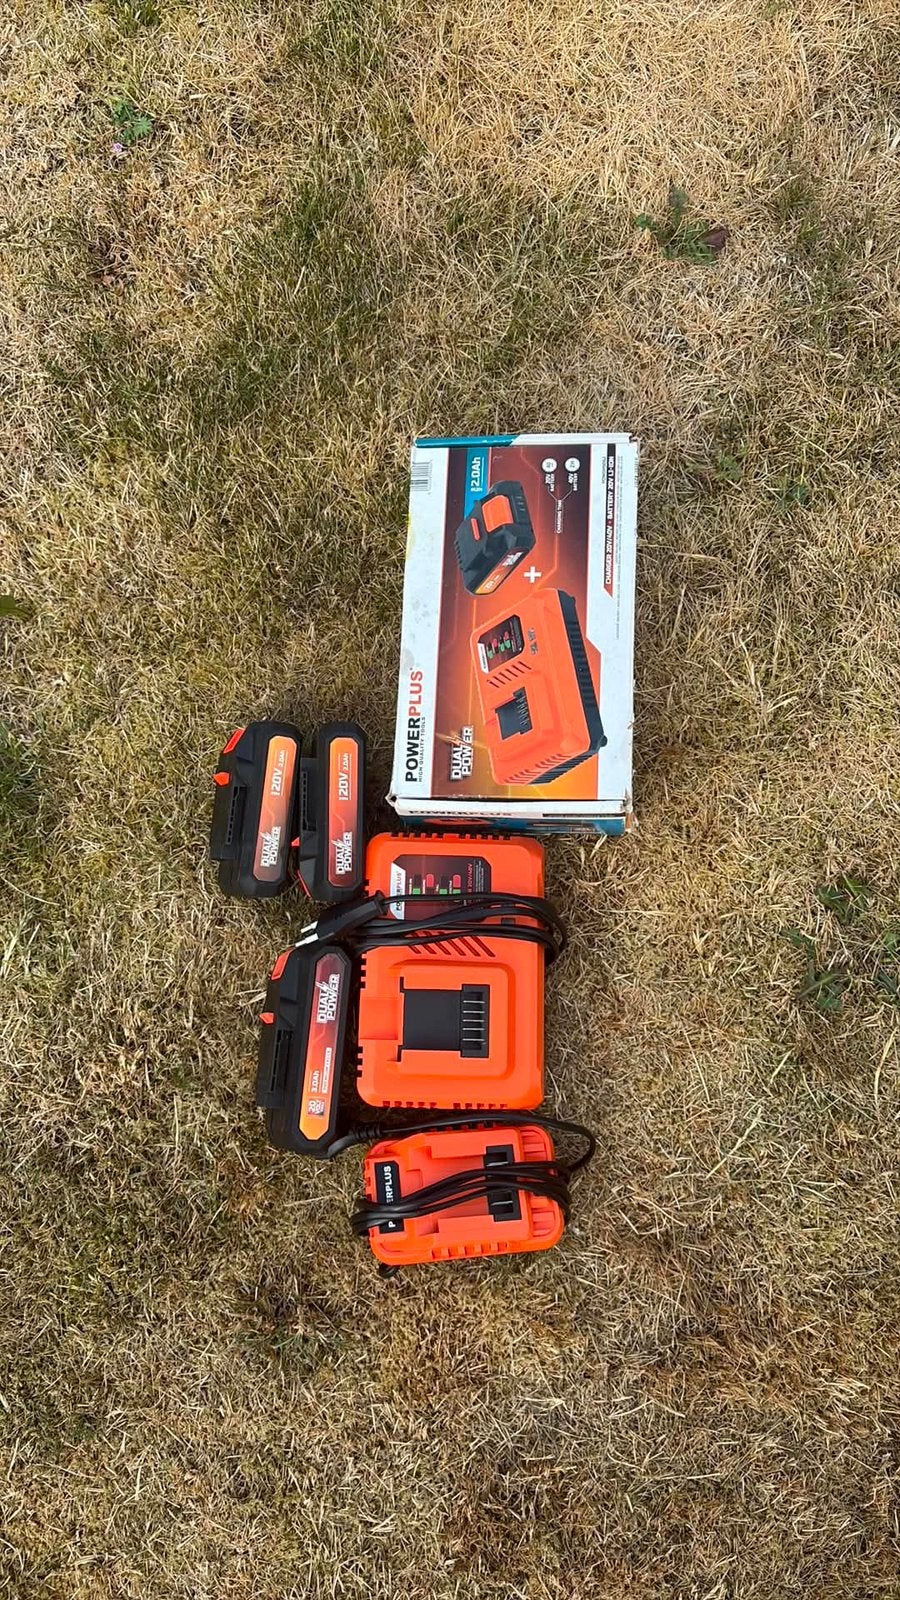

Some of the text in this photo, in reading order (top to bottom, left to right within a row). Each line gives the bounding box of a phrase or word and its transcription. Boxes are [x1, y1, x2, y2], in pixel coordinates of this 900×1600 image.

[471, 456, 481, 487] 2.0Ah
[405, 671, 422, 782] POWERPLUS
[451, 744, 462, 779] DUAL
[462, 726, 473, 775] POWER
[271, 768, 282, 791] 20V
[339, 773, 348, 796] 20V
[261, 839, 270, 867] DUAL
[270, 826, 281, 864] POWER
[336, 846, 345, 874] DUAL
[344, 832, 352, 871] POWER
[316, 990, 328, 1023] DUAL
[326, 974, 339, 1020] POWER
[311, 1070, 320, 1093] 3.0Ah
[309, 1100, 316, 1113] 20
[384, 1166, 396, 1228] PERPLUS
